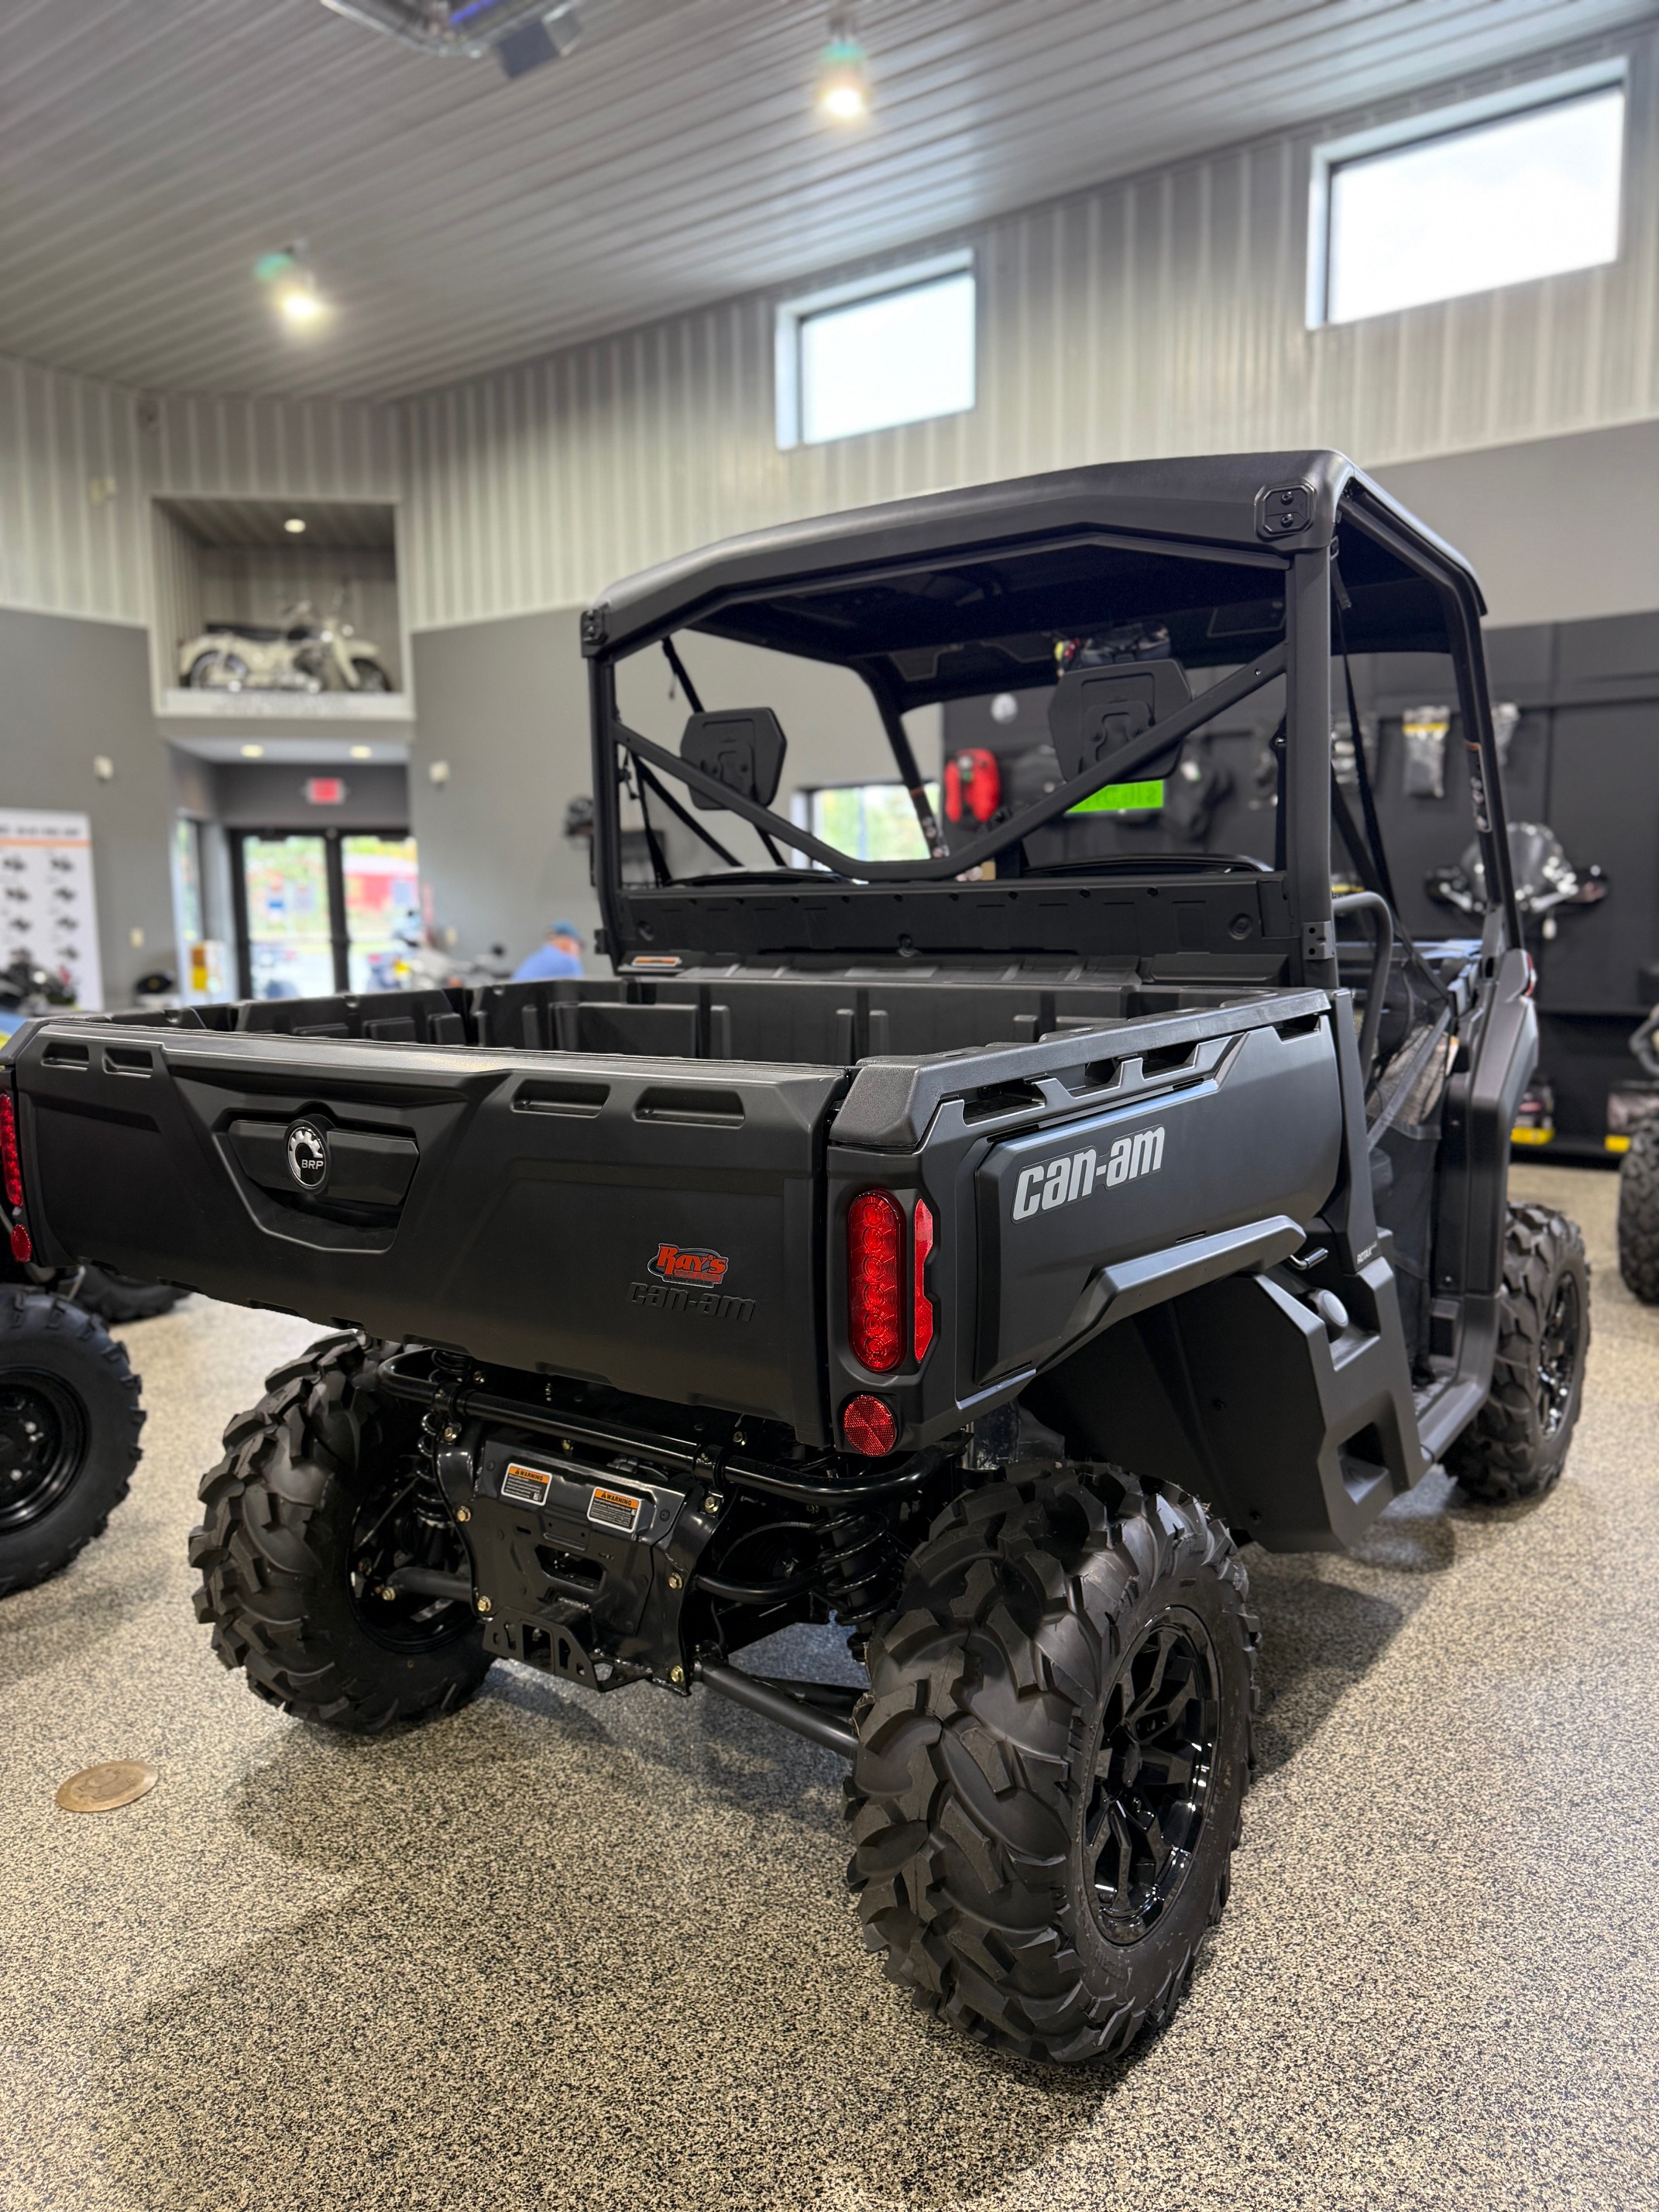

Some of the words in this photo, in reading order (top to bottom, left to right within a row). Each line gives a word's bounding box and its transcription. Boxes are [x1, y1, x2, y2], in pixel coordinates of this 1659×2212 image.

[301, 1159, 324, 1170] BRP
[1013, 1127, 1165, 1221] can-am
[657, 1246, 726, 1276] Ray's
[627, 1282, 755, 1322] can-am
[520, 1471, 544, 1481] WARNING
[606, 1495, 632, 1506] WARNING
